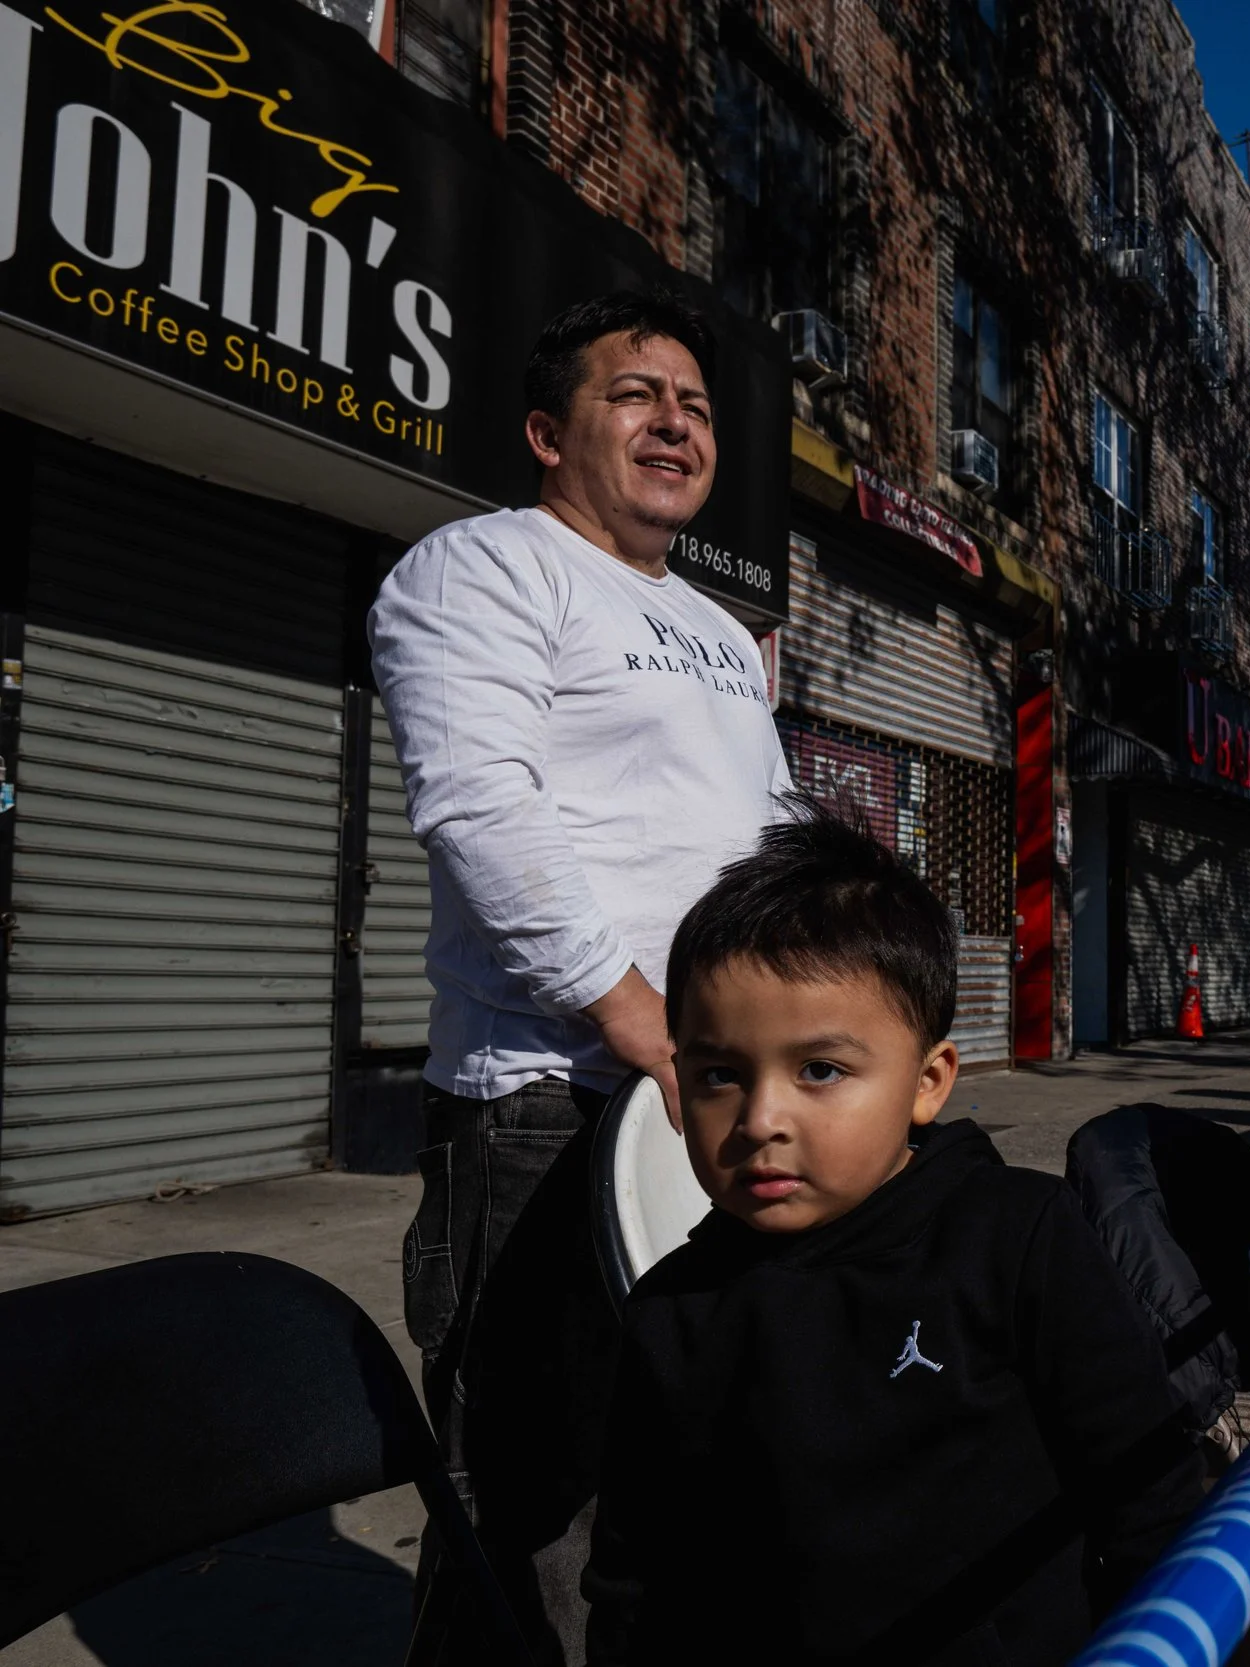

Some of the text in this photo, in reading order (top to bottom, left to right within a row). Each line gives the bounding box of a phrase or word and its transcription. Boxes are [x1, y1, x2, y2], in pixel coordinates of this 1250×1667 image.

[45, 0, 399, 218] Big
[0, 3, 452, 410] John's
[49, 261, 444, 455] Coffee Shop & Grill
[624, 653, 705, 683] RALPH
[640, 612, 746, 674] POLO
